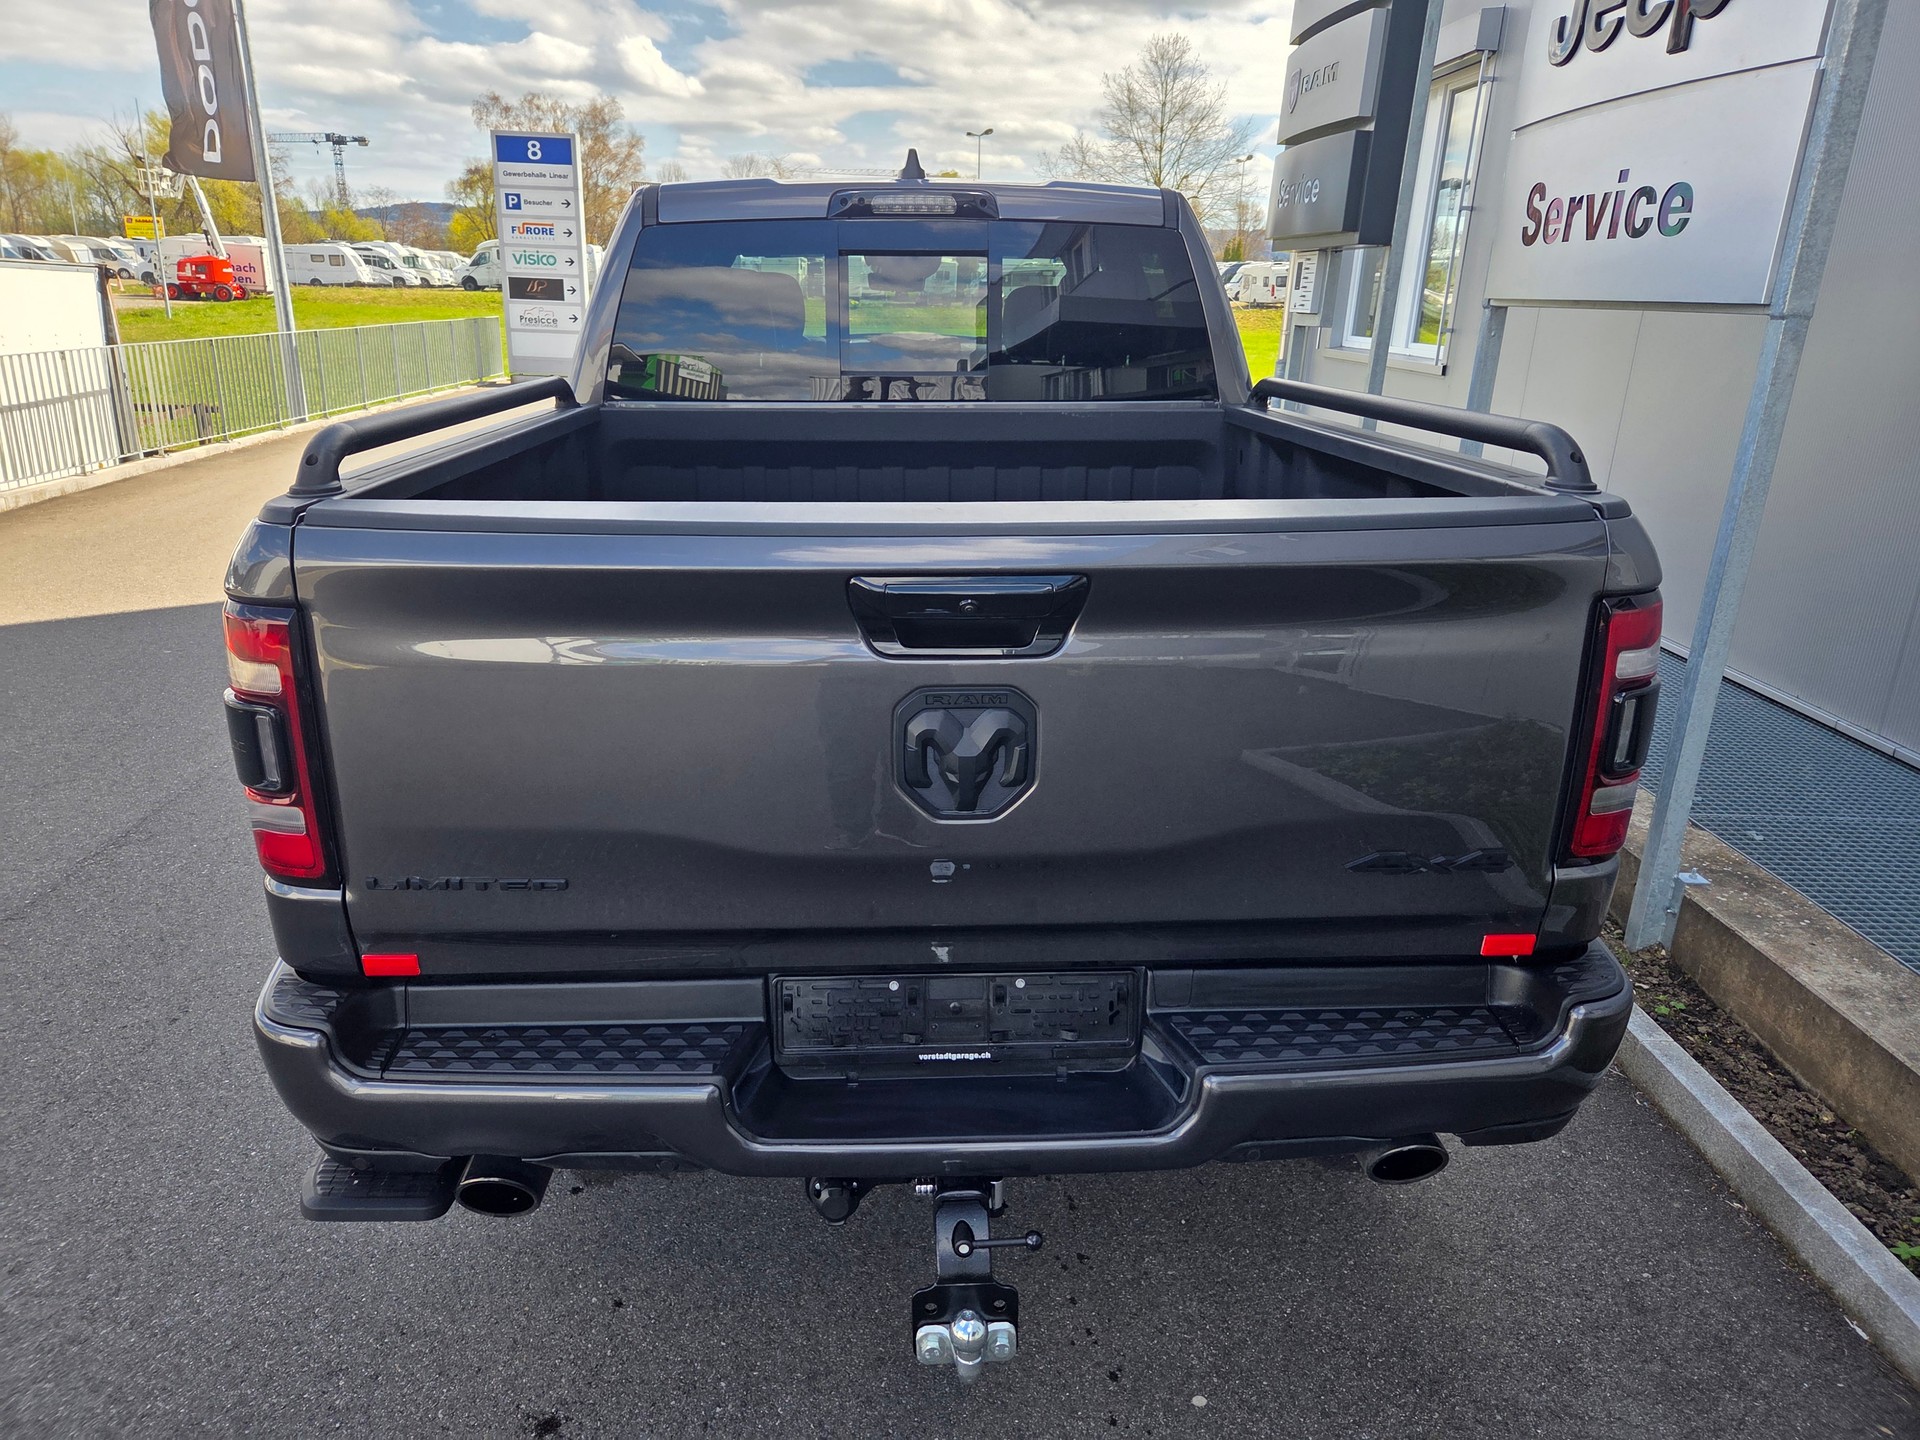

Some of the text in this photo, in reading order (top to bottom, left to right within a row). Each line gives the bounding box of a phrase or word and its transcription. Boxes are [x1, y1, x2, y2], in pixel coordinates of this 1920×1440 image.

[183, 0, 221, 163] DOD
[1300, 61, 1340, 95] RAM
[527, 140, 542, 161] 8
[502, 170, 569, 180] Gewerbehalle Linear
[1277, 173, 1321, 209] Service
[508, 195, 518, 208] P
[1521, 168, 1694, 247] Service
[511, 222, 555, 236] FURORE
[519, 315, 558, 325] Presicce
[925, 694, 1009, 706] RAM
[365, 876, 569, 892] LIMITED
[918, 1051, 991, 1062] vorstadtgarage.ch
